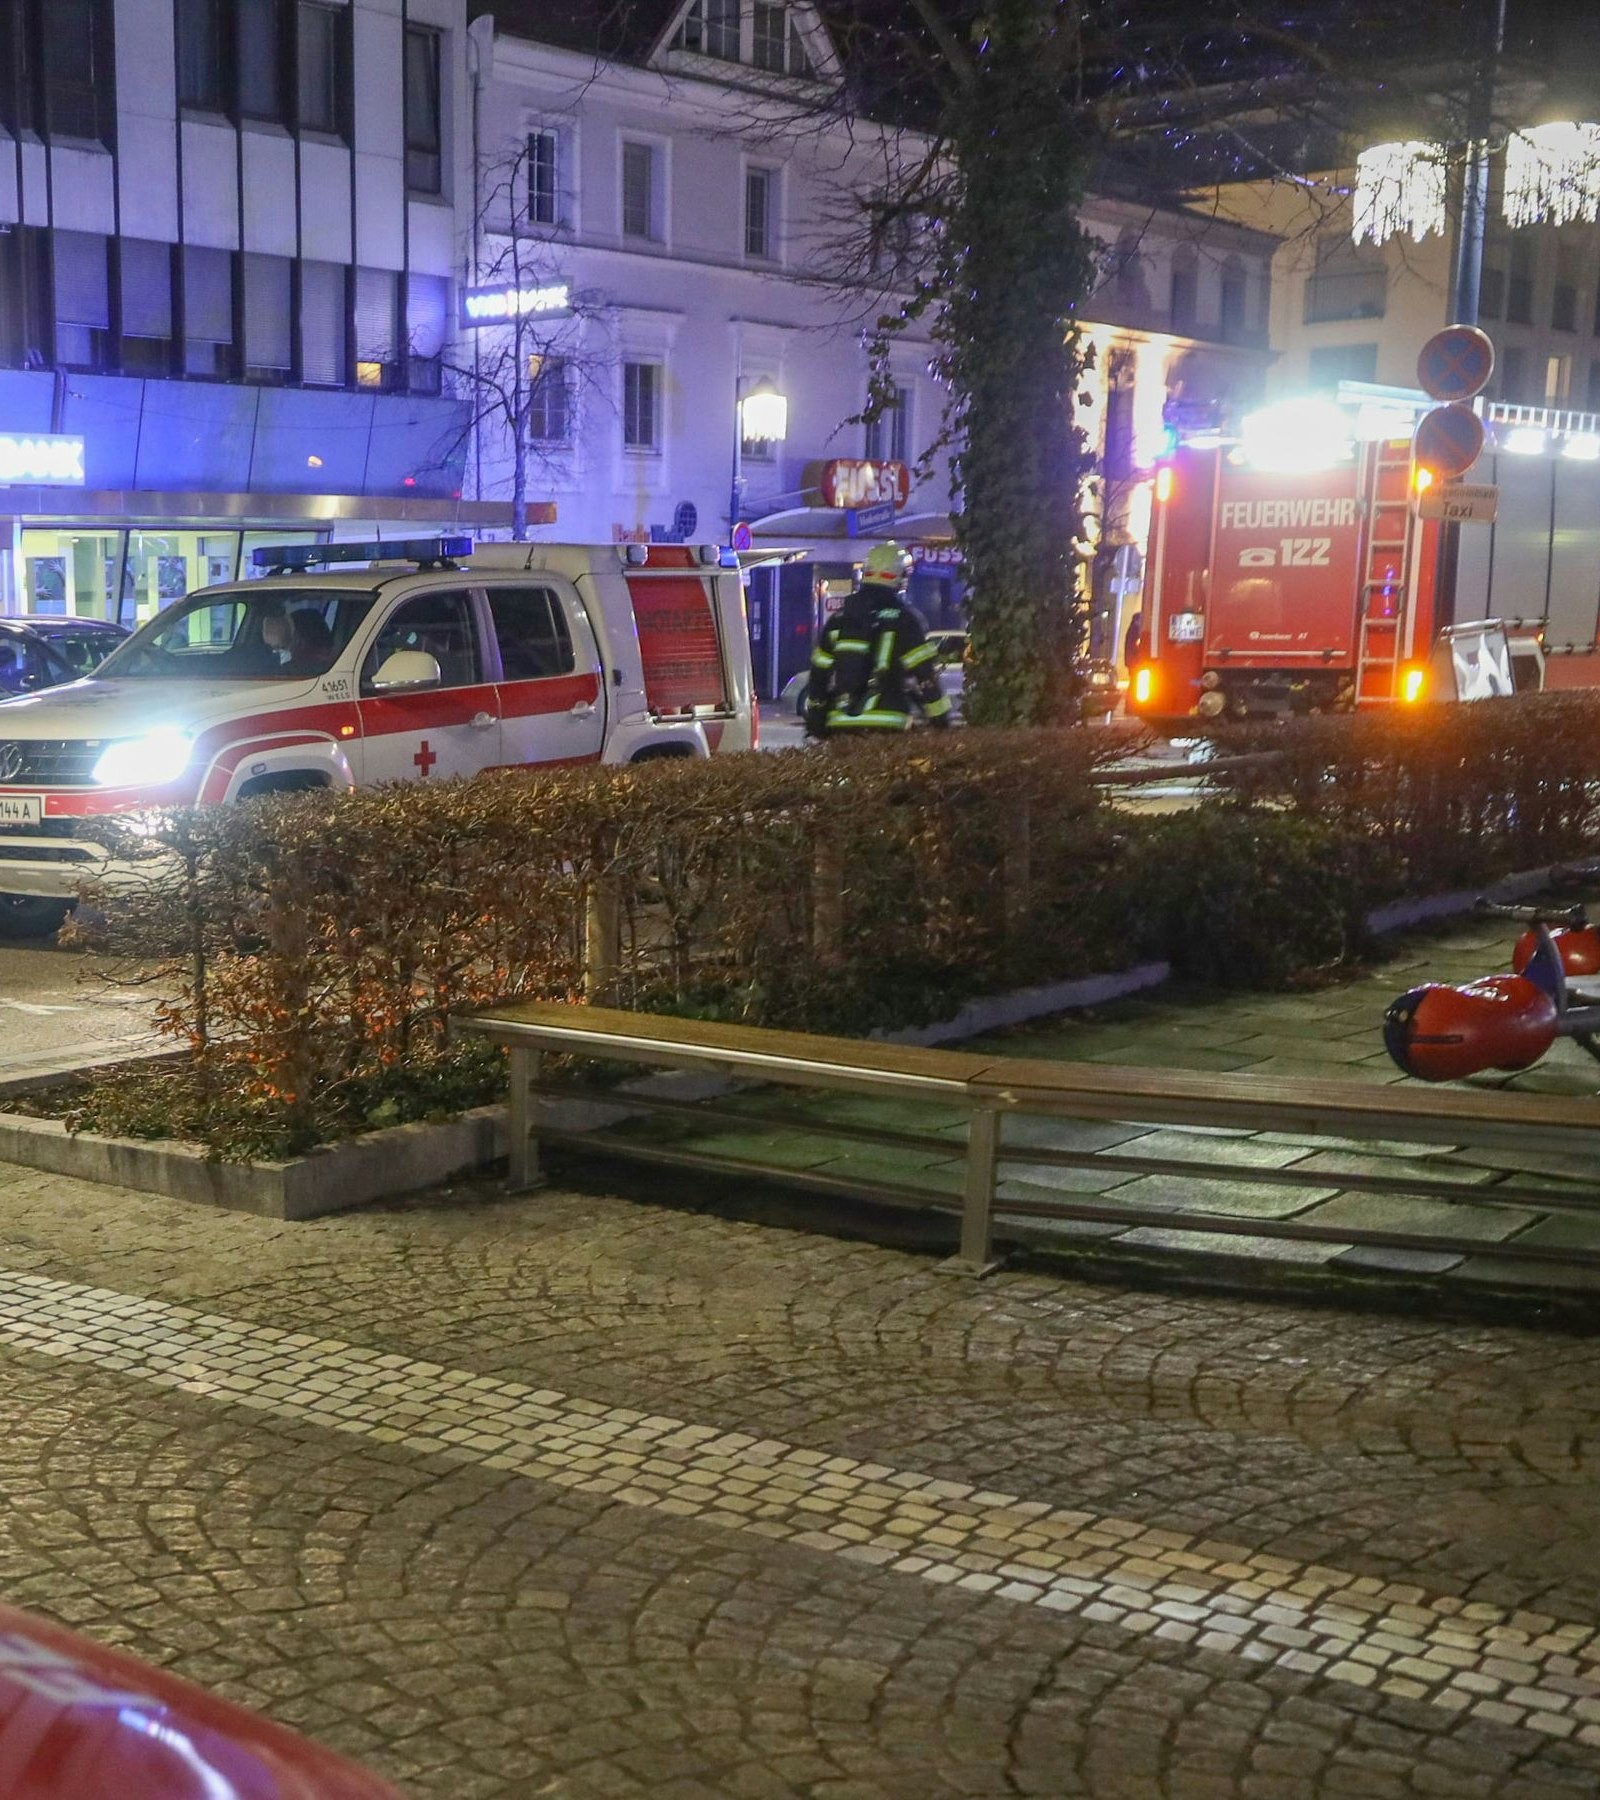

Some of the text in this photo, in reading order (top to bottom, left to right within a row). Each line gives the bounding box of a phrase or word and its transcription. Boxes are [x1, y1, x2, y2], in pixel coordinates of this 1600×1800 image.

[835, 464, 903, 507] FUSSL
[1221, 498, 1355, 528] FEUERWEHR
[1443, 501, 1473, 518] Taxi
[1280, 538, 1331, 566] 122
[322, 680, 348, 691] 41651
